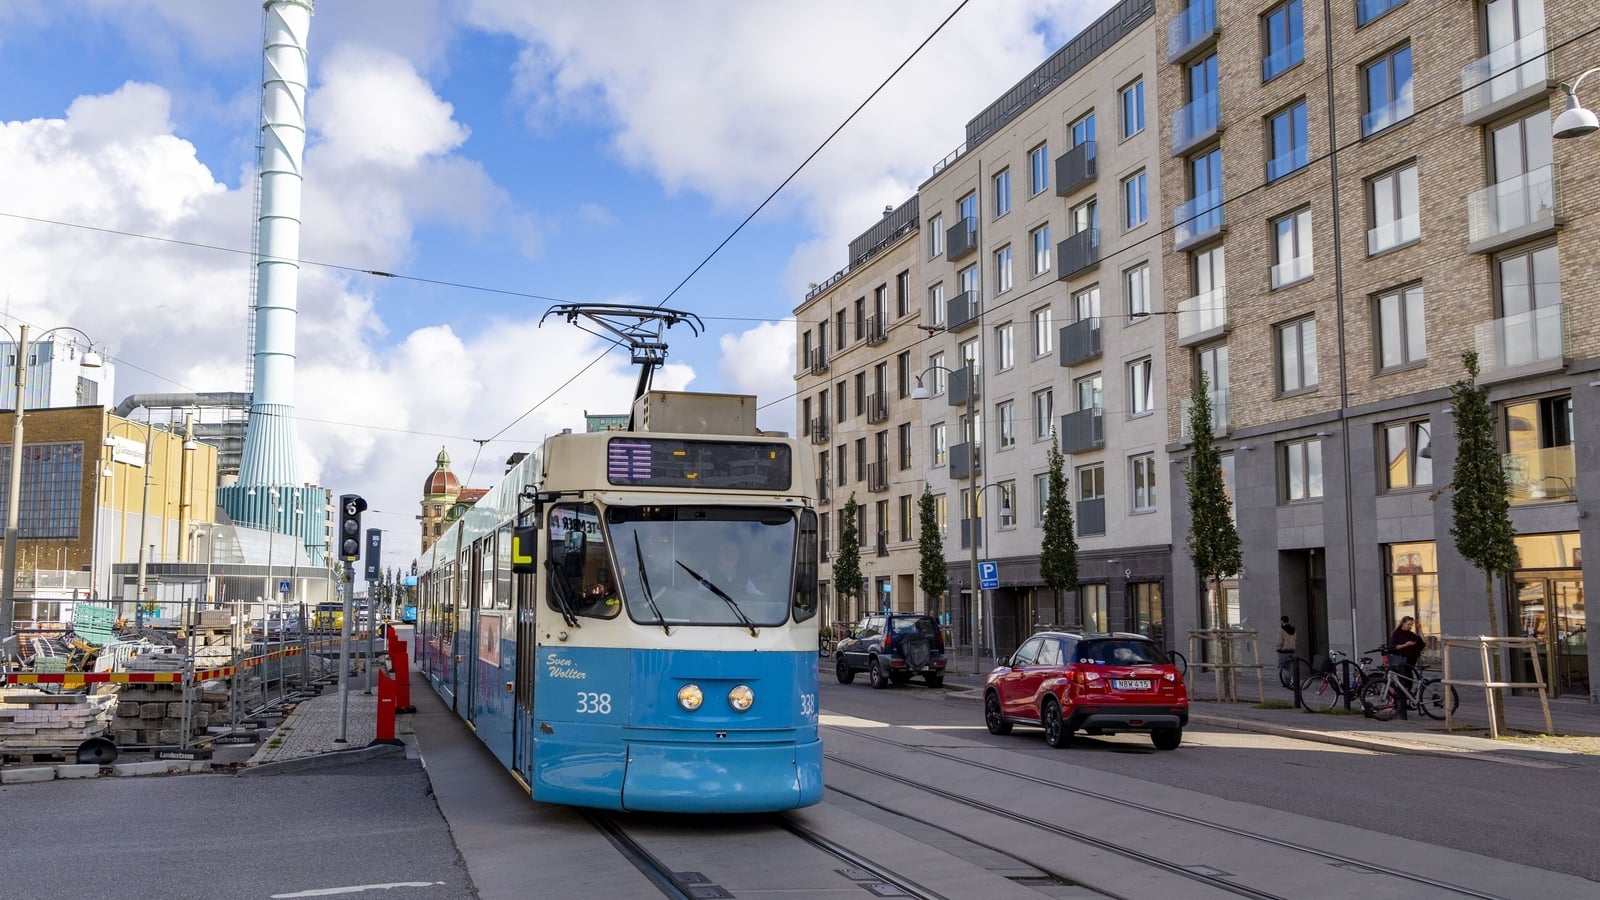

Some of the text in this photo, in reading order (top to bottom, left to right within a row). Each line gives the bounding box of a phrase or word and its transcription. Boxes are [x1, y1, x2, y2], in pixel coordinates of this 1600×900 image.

[983, 564, 994, 578] P
[546, 653, 572, 666] Sven
[548, 665, 586, 679] Wollter
[1118, 680, 1149, 688] NBW 415
[576, 692, 612, 715] 338
[800, 694, 815, 715] 338
